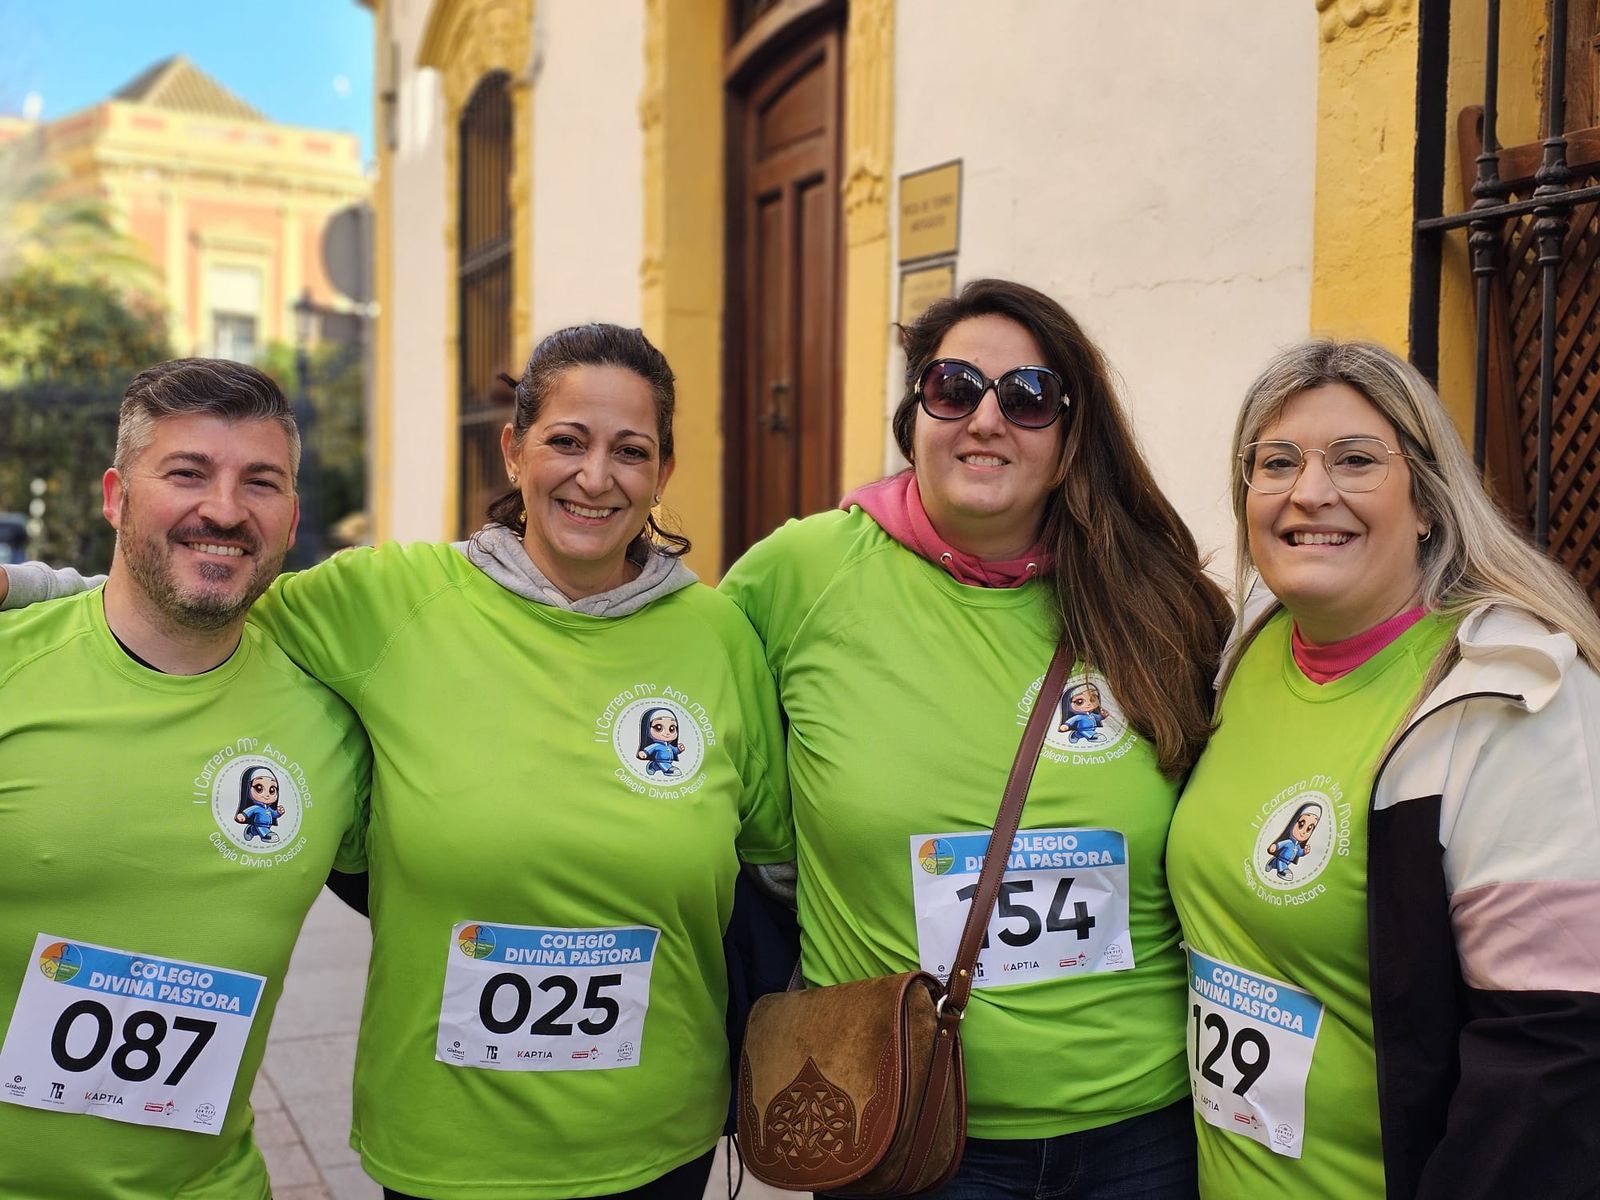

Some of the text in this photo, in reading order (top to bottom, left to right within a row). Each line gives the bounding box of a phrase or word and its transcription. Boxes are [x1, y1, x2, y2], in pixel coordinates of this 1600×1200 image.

[596, 690, 634, 729] Carrera
[663, 685, 689, 705] Ana
[689, 702, 716, 746] Mogas
[1072, 754, 1105, 765] Divina
[1105, 734, 1138, 761] Pastora
[194, 745, 234, 789] Carrera
[263, 743, 287, 765] Ana
[288, 762, 313, 809] Mogas
[614, 767, 646, 794] Colegio
[648, 787, 679, 799] Divina
[1262, 780, 1307, 815] Carrera
[1337, 802, 1352, 857] Mogas
[209, 831, 307, 868] Colegio Divina Pastora
[1012, 835, 1078, 852] OLEGIO
[965, 855, 1027, 871] DINA
[1029, 850, 1113, 869] PASTORA
[1257, 886, 1282, 906] Divina
[1284, 882, 1326, 907] Pastora
[505, 947, 566, 965] DIVINA
[569, 947, 642, 965] PASTORA
[540, 933, 617, 949] COLEGIO
[129, 959, 214, 988] COLEGIO
[1003, 961, 1040, 971] KAPTIA
[89, 971, 241, 1012] DIVINA PASTORA
[1212, 967, 1278, 1003] COLEGIO
[479, 972, 622, 1036] 025
[1195, 975, 1304, 1032] DIVINA PASTORA
[51, 1000, 218, 1087] 087
[517, 1050, 553, 1058] KAPTIA
[1193, 1003, 1271, 1098] 129
[84, 1091, 124, 1105] KAPTIA
